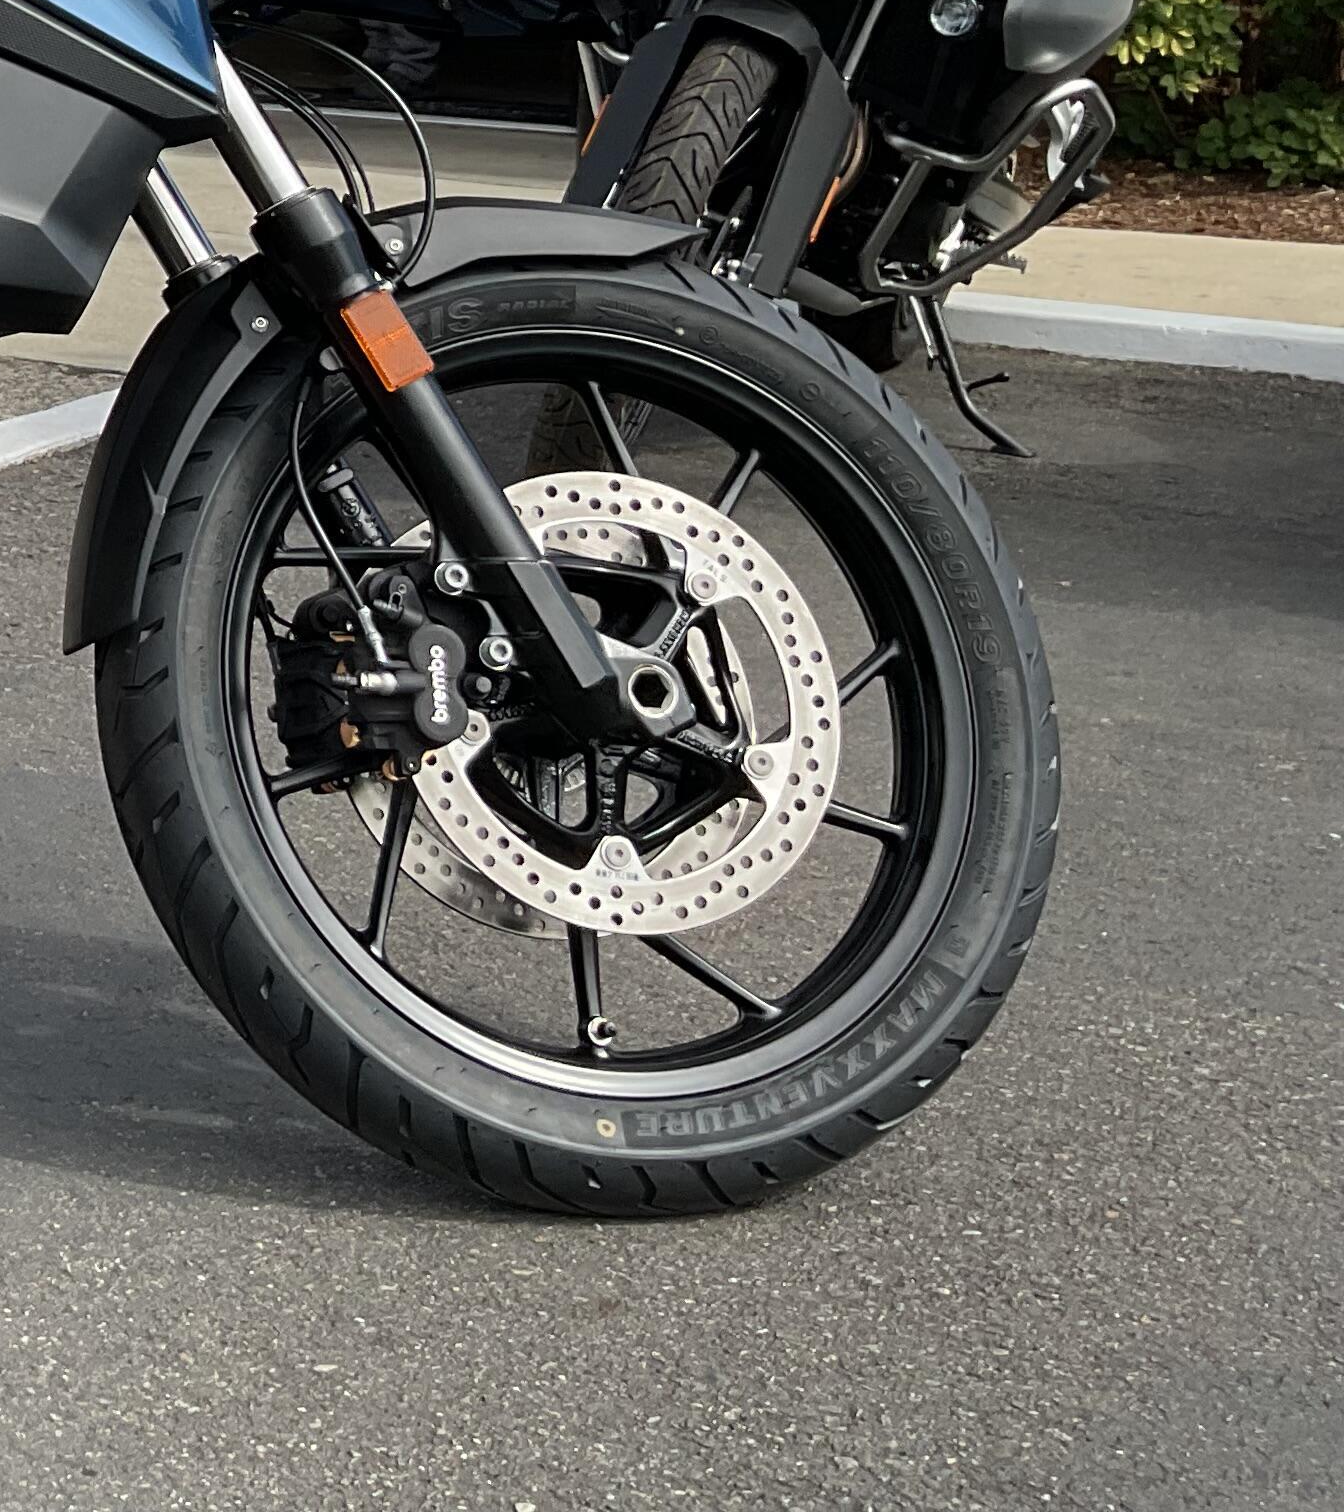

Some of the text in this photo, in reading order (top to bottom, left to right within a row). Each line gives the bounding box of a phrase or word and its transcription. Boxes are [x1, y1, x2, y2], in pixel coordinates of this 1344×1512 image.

[497, 296, 571, 314] RADIAL
[861, 436, 1003, 670] 110/80R19
[427, 644, 449, 724] brembo
[634, 972, 946, 1139] MAXXVENTURE
